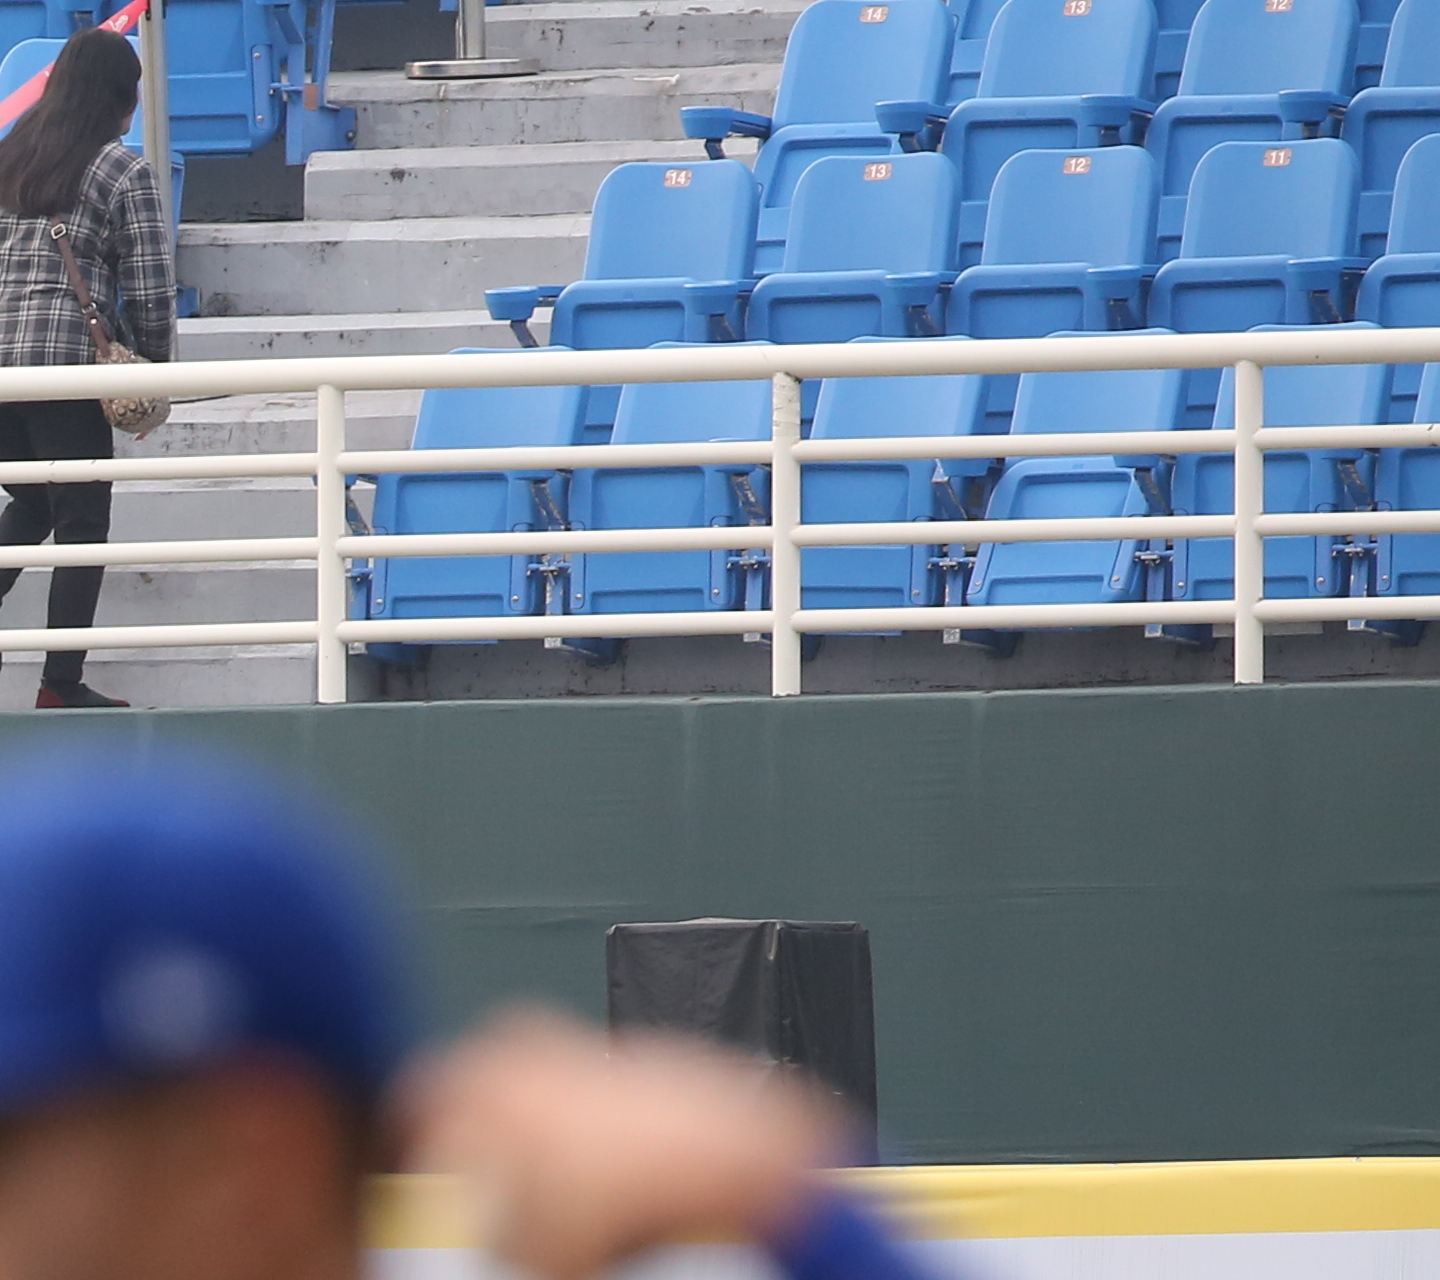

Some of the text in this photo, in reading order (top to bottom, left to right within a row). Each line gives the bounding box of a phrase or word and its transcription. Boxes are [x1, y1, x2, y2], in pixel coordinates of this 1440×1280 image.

[867, 7, 883, 21] 14
[1070, 0, 1087, 14] 13
[1070, 157, 1086, 172] 12
[1270, 150, 1285, 165] 11
[669, 170, 686, 185] 14
[870, 164, 887, 178] 13
